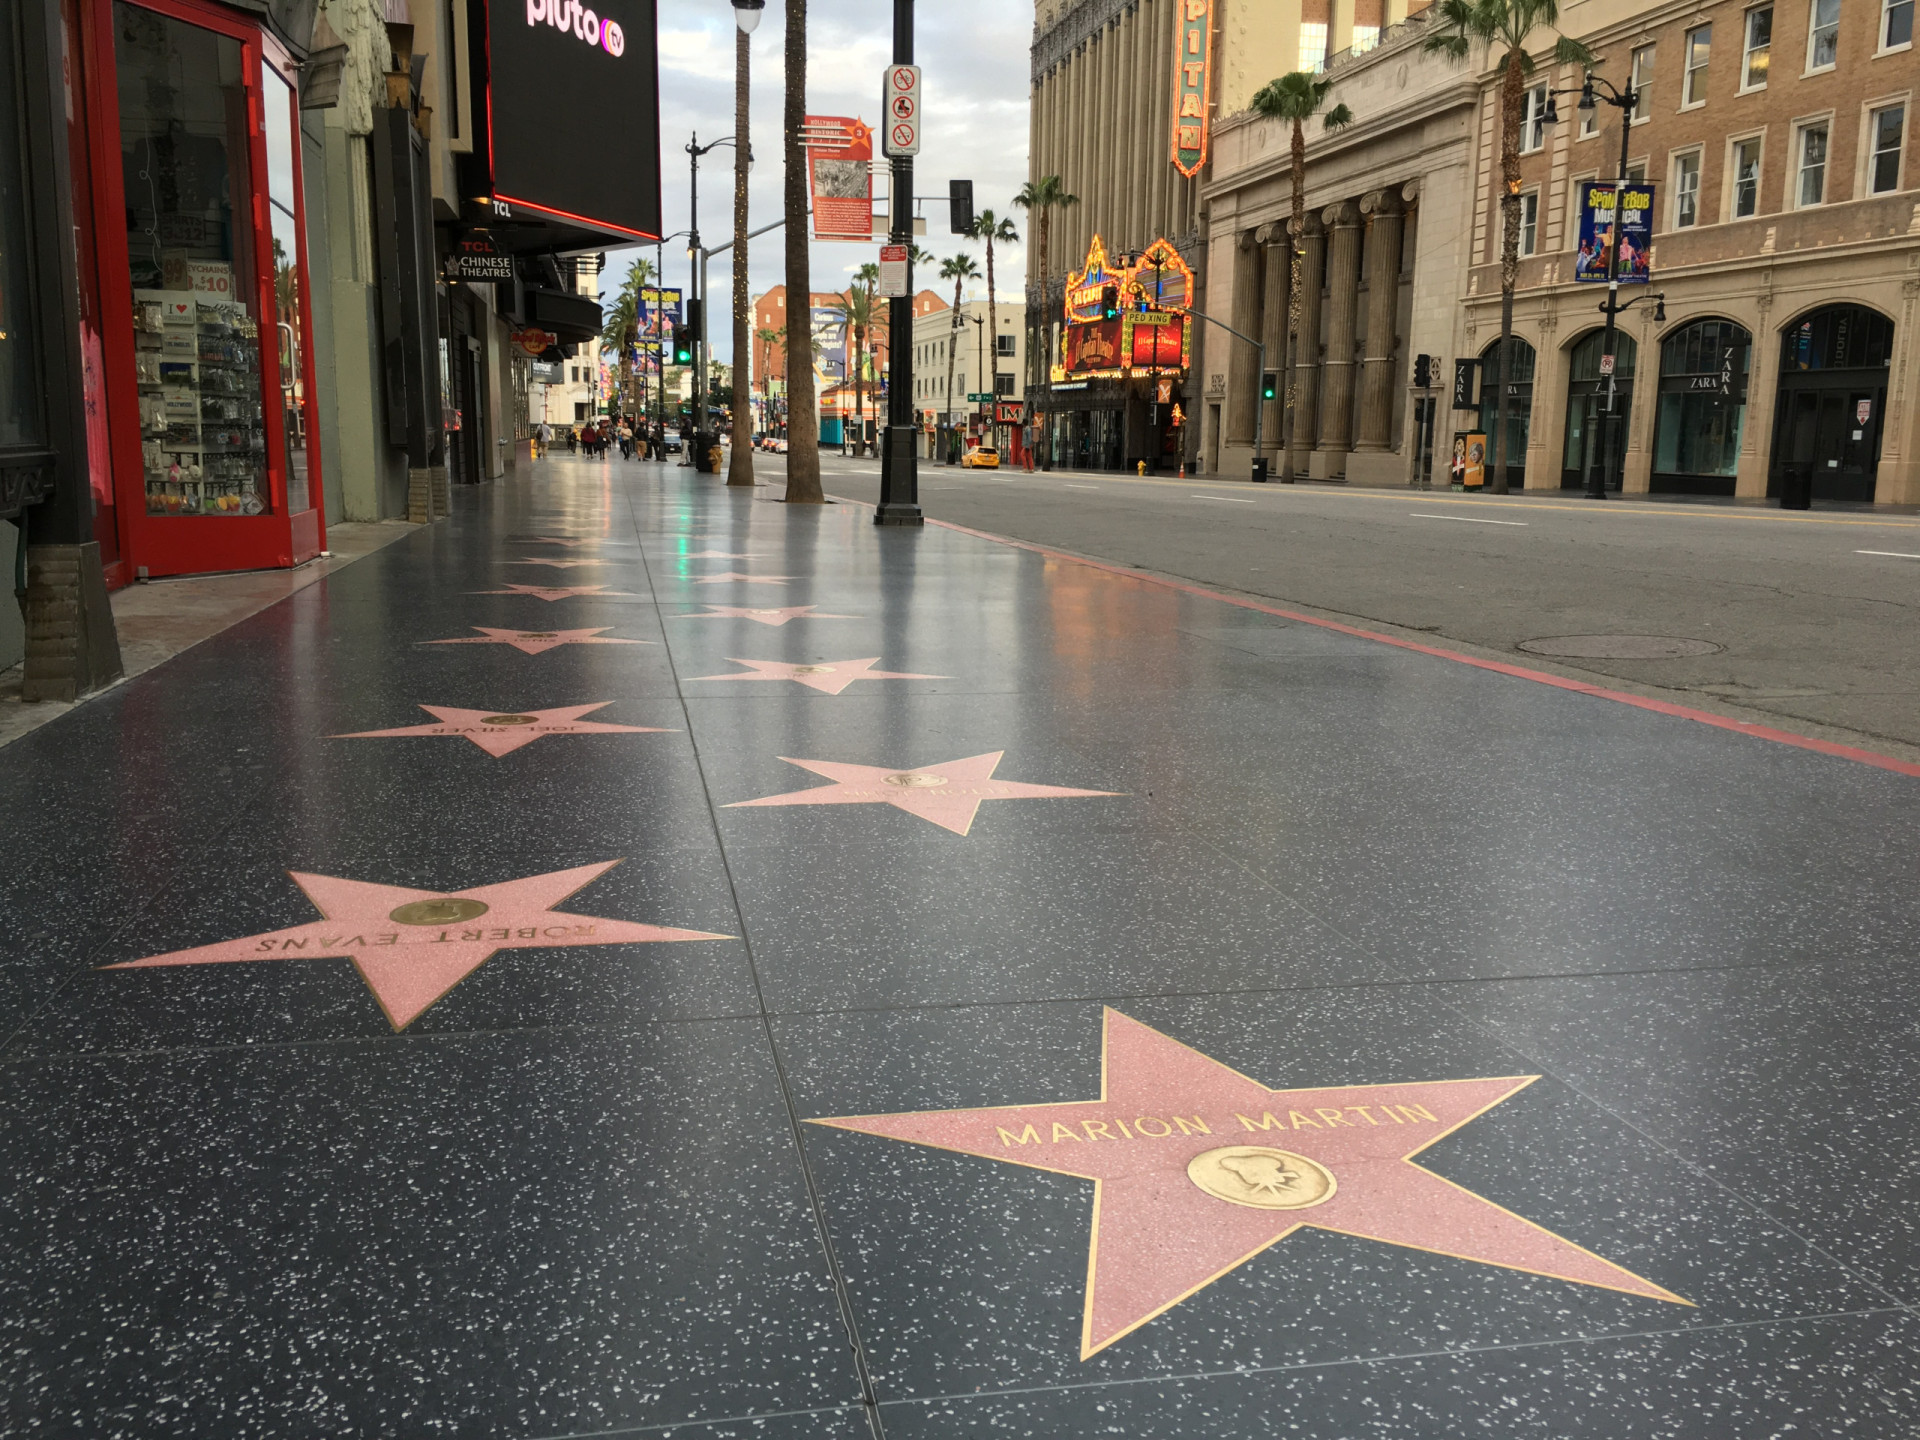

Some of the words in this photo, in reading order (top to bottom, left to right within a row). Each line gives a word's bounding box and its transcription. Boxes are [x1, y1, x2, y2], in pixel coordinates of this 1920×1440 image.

[526, 0, 600, 46] pluto
[611, 29, 622, 48] tv
[811, 119, 840, 127] HOLLYWOOD
[856, 129, 863, 137] 3
[492, 200, 511, 217] TCL
[461, 241, 494, 252] TCL
[460, 256, 511, 268] CHINESE
[461, 267, 512, 278] THEATRES
[168, 303, 174, 314] I
[815, 312, 834, 322] Curious
[1129, 313, 1146, 322] PED
[1148, 314, 1168, 323] XING
[1719, 346, 1734, 395] ZARA
[1456, 366, 1465, 402] ZARA
[1690, 376, 1717, 389] ZARA
[1508, 385, 1517, 394] RA
[431, 726, 508, 734] SILVER
[429, 925, 597, 943] ROBERT
[254, 932, 400, 953] EVANS
[995, 1115, 1213, 1147] MARION
[1235, 1103, 1439, 1132] MARTIN
